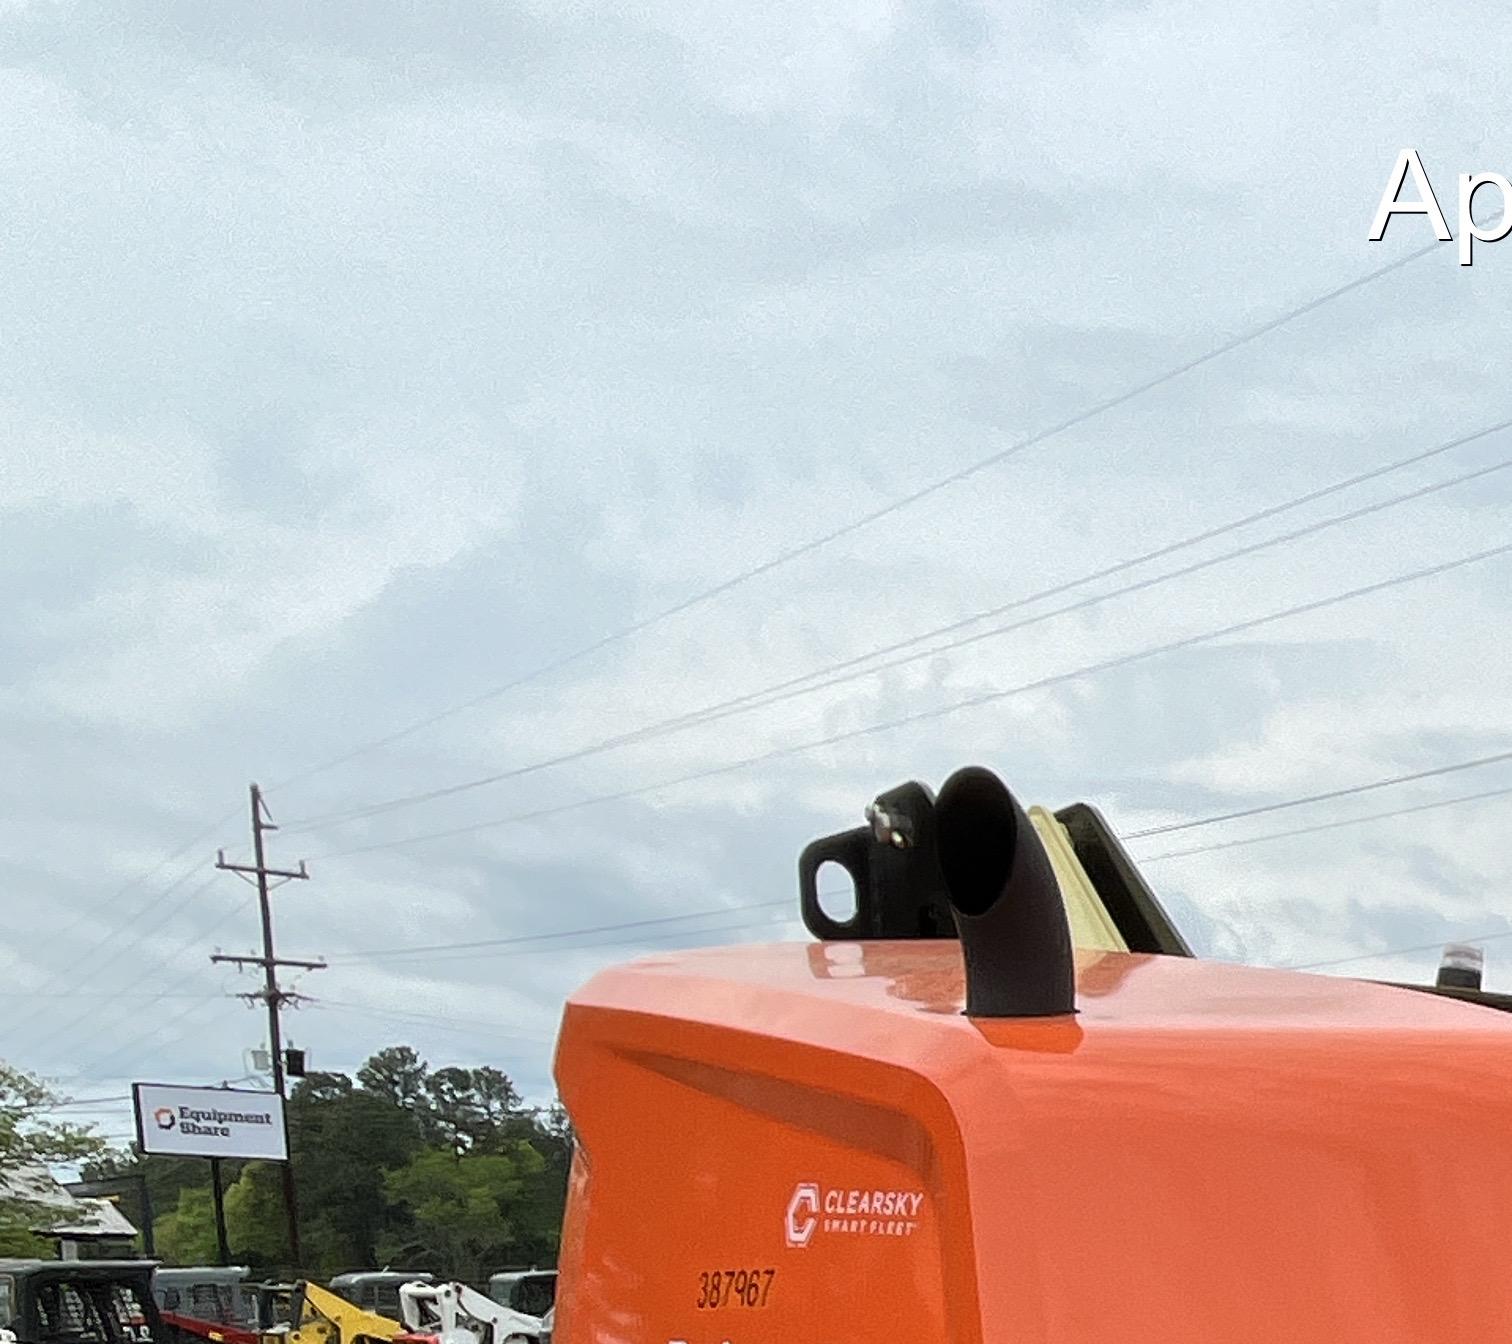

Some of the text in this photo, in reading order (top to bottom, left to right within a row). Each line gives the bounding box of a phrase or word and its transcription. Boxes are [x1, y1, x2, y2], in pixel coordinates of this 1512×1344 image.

[178, 1106, 273, 1126] Equipment
[180, 1122, 231, 1137] Share
[824, 1190, 924, 1216] CLEARSKY
[823, 1218, 867, 1233] SMART
[696, 1268, 776, 1309] 387967
